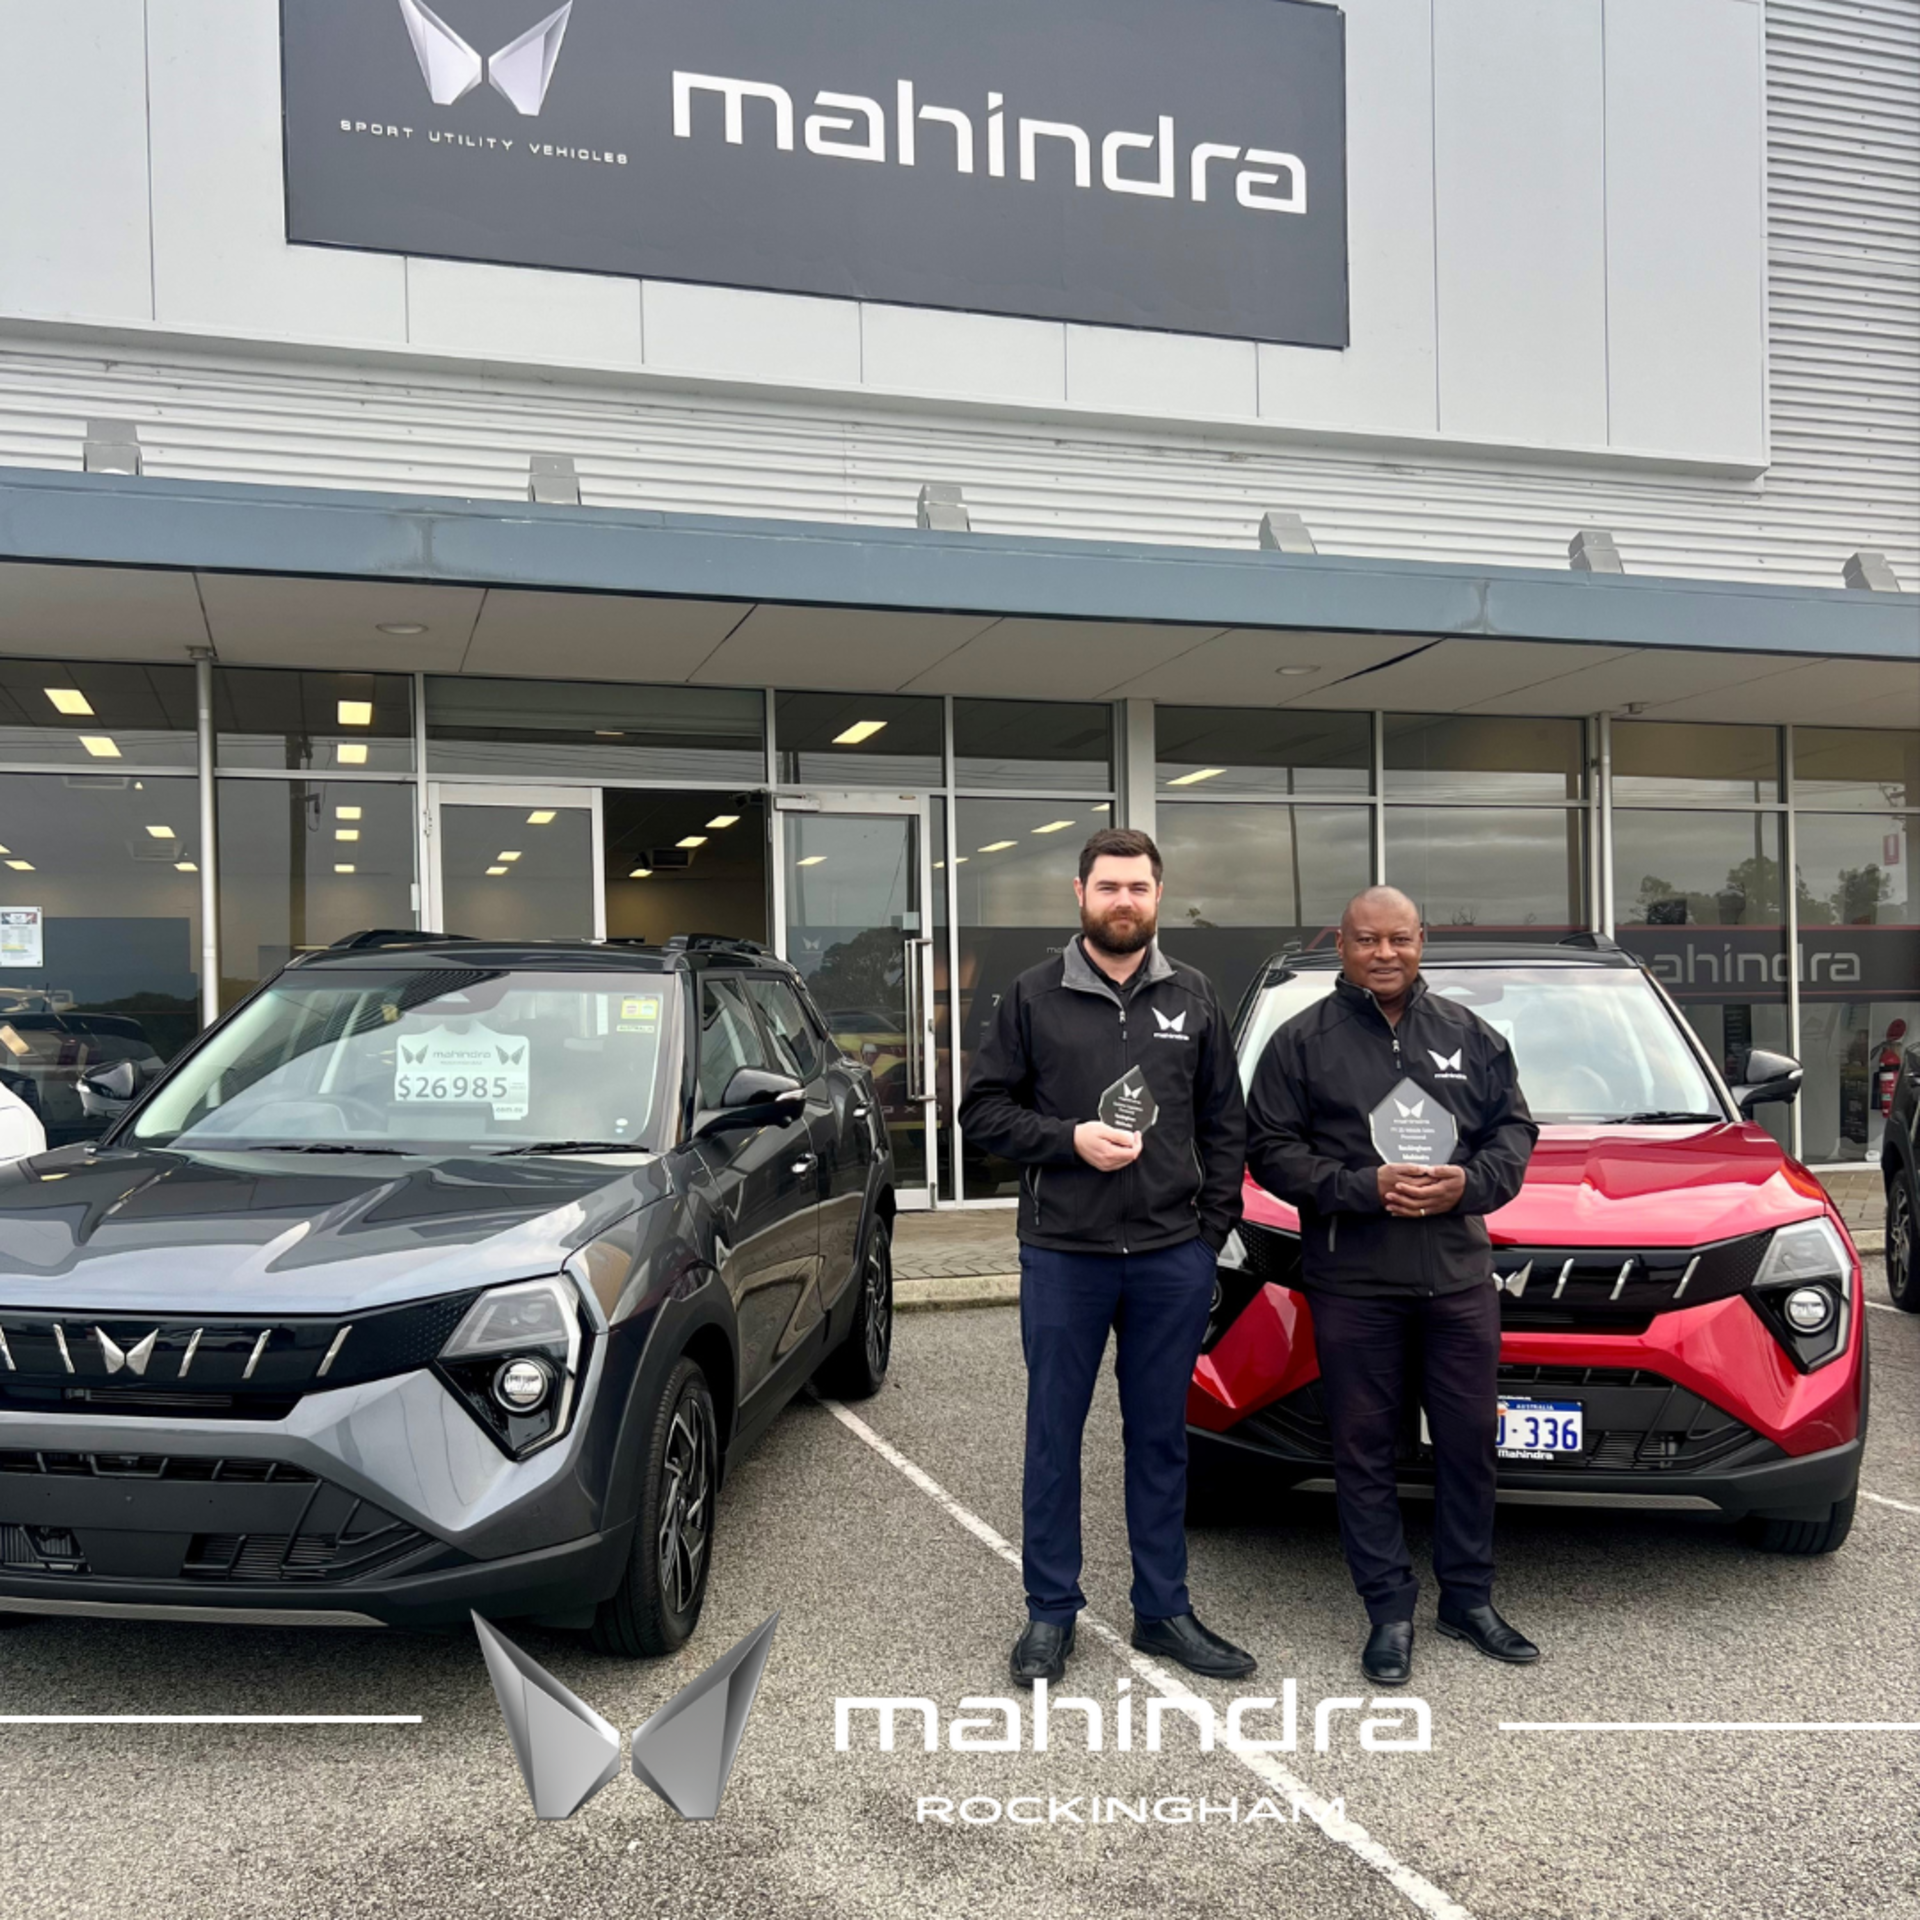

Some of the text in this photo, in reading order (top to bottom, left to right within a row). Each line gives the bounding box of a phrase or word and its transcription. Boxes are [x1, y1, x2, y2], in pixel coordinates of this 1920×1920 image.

[340, 120, 628, 164] SPORT UTILITY VEHICLES
[672, 70, 1307, 214] mahindra
[1640, 943, 1860, 983] ahindra
[432, 1049, 491, 1059] mahindra
[397, 1074, 508, 1100] $26985
